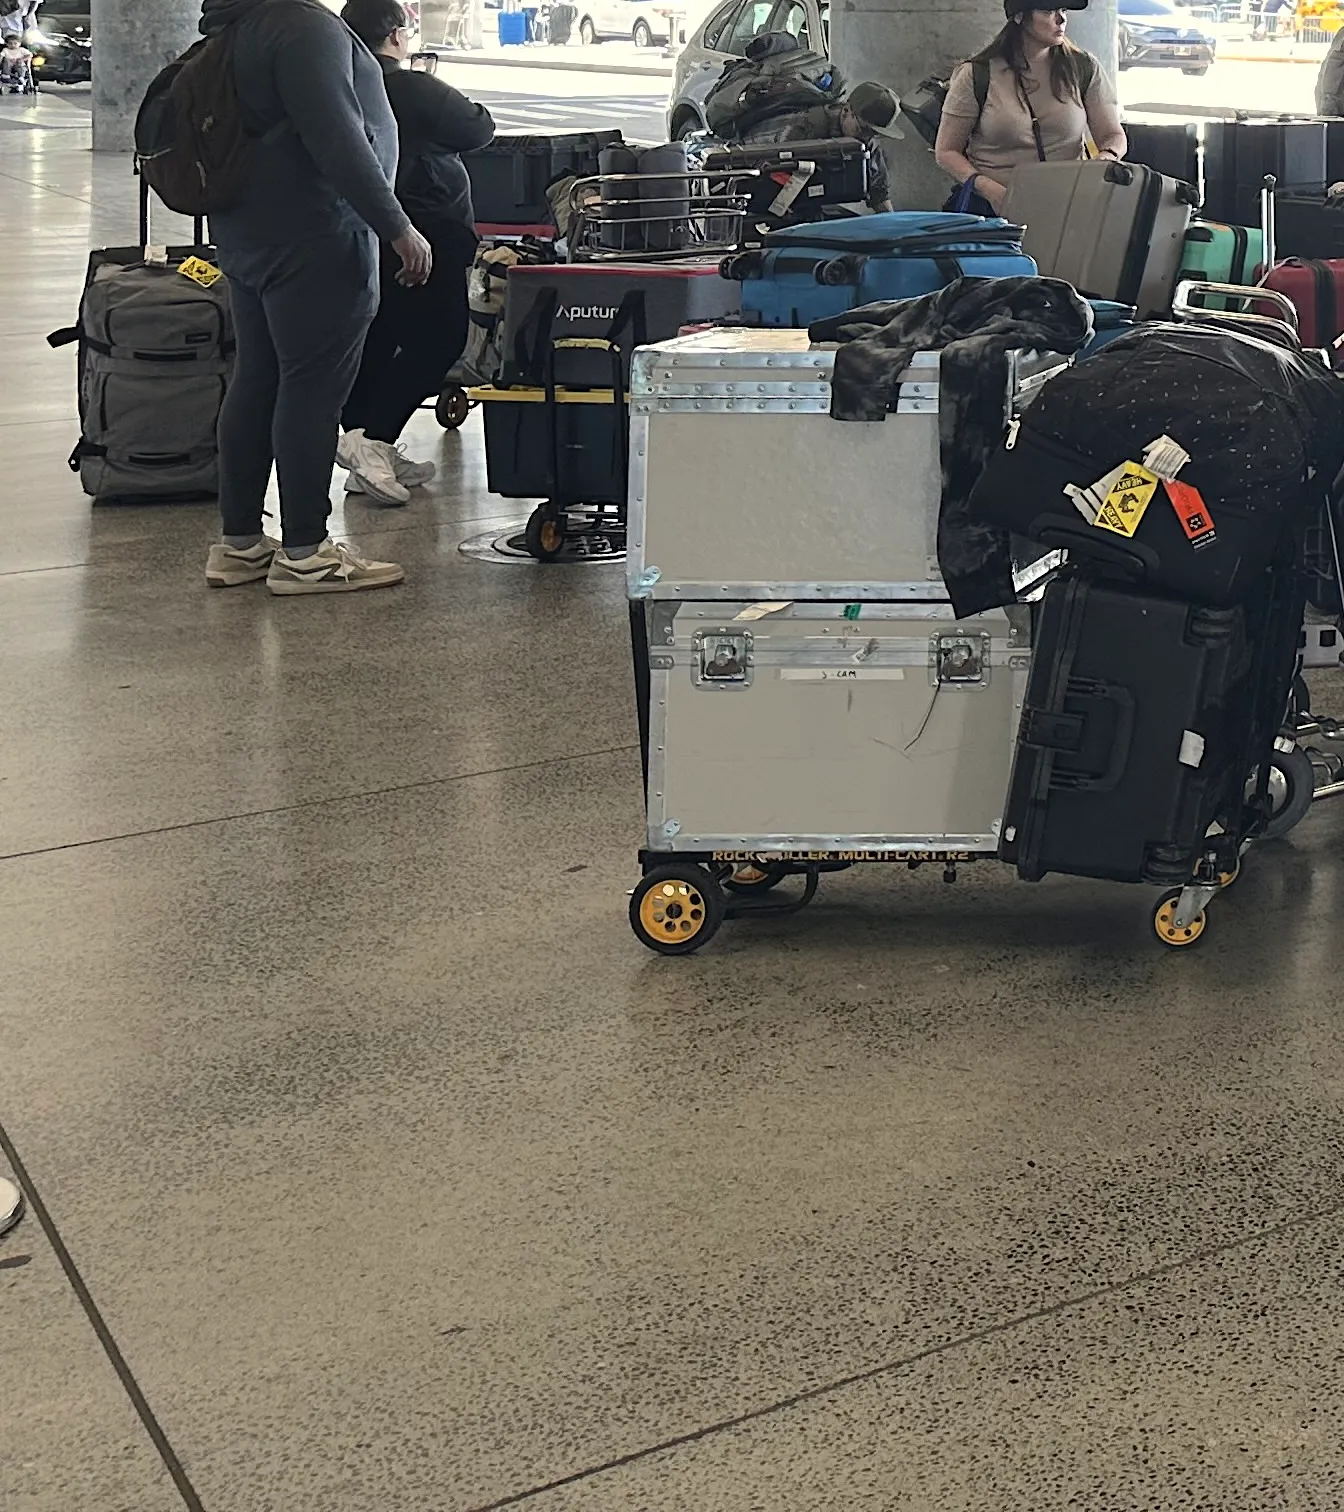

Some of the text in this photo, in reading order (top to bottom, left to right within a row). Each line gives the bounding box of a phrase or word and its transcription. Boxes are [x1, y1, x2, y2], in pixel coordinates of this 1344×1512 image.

[555, 304, 620, 322] Aputur
[1116, 475, 1144, 492] HEAVY
[945, 851, 969, 861] R2
